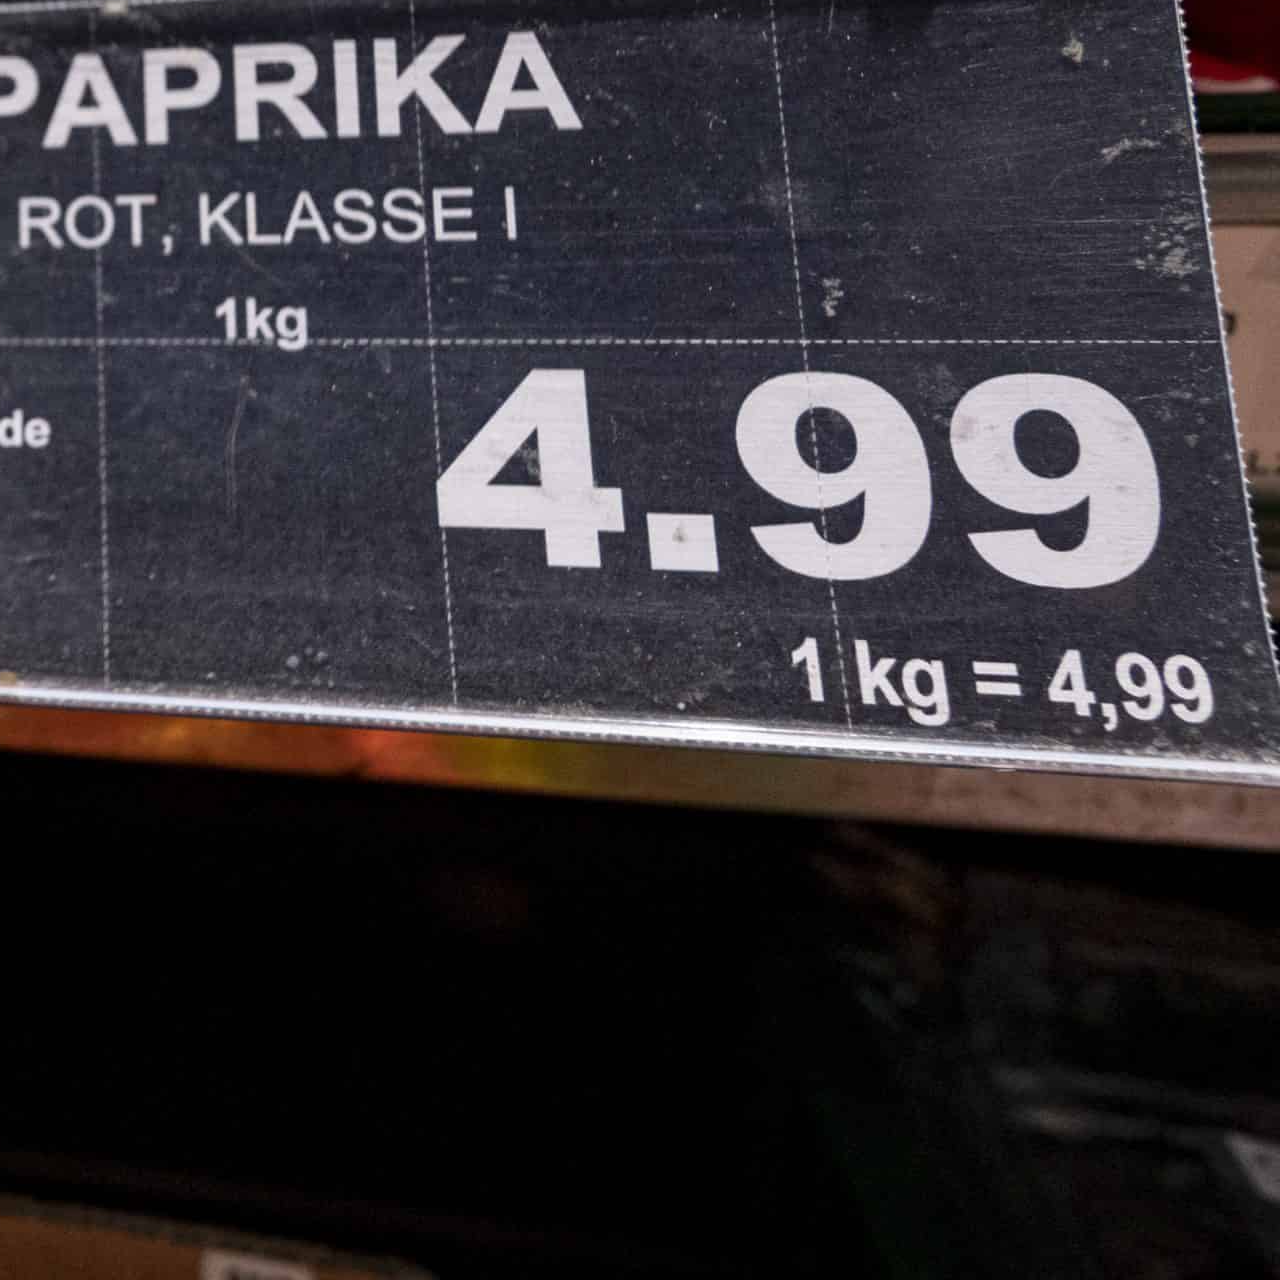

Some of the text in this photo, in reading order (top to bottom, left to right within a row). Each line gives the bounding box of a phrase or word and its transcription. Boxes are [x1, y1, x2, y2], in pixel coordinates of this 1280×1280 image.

[18, 186, 517, 255] ROT, KLASSE I
[214, 297, 309, 351] 1kg
[435, 368, 1161, 590] 4.99
[792, 637, 1215, 731] 1 kg = 4,99
